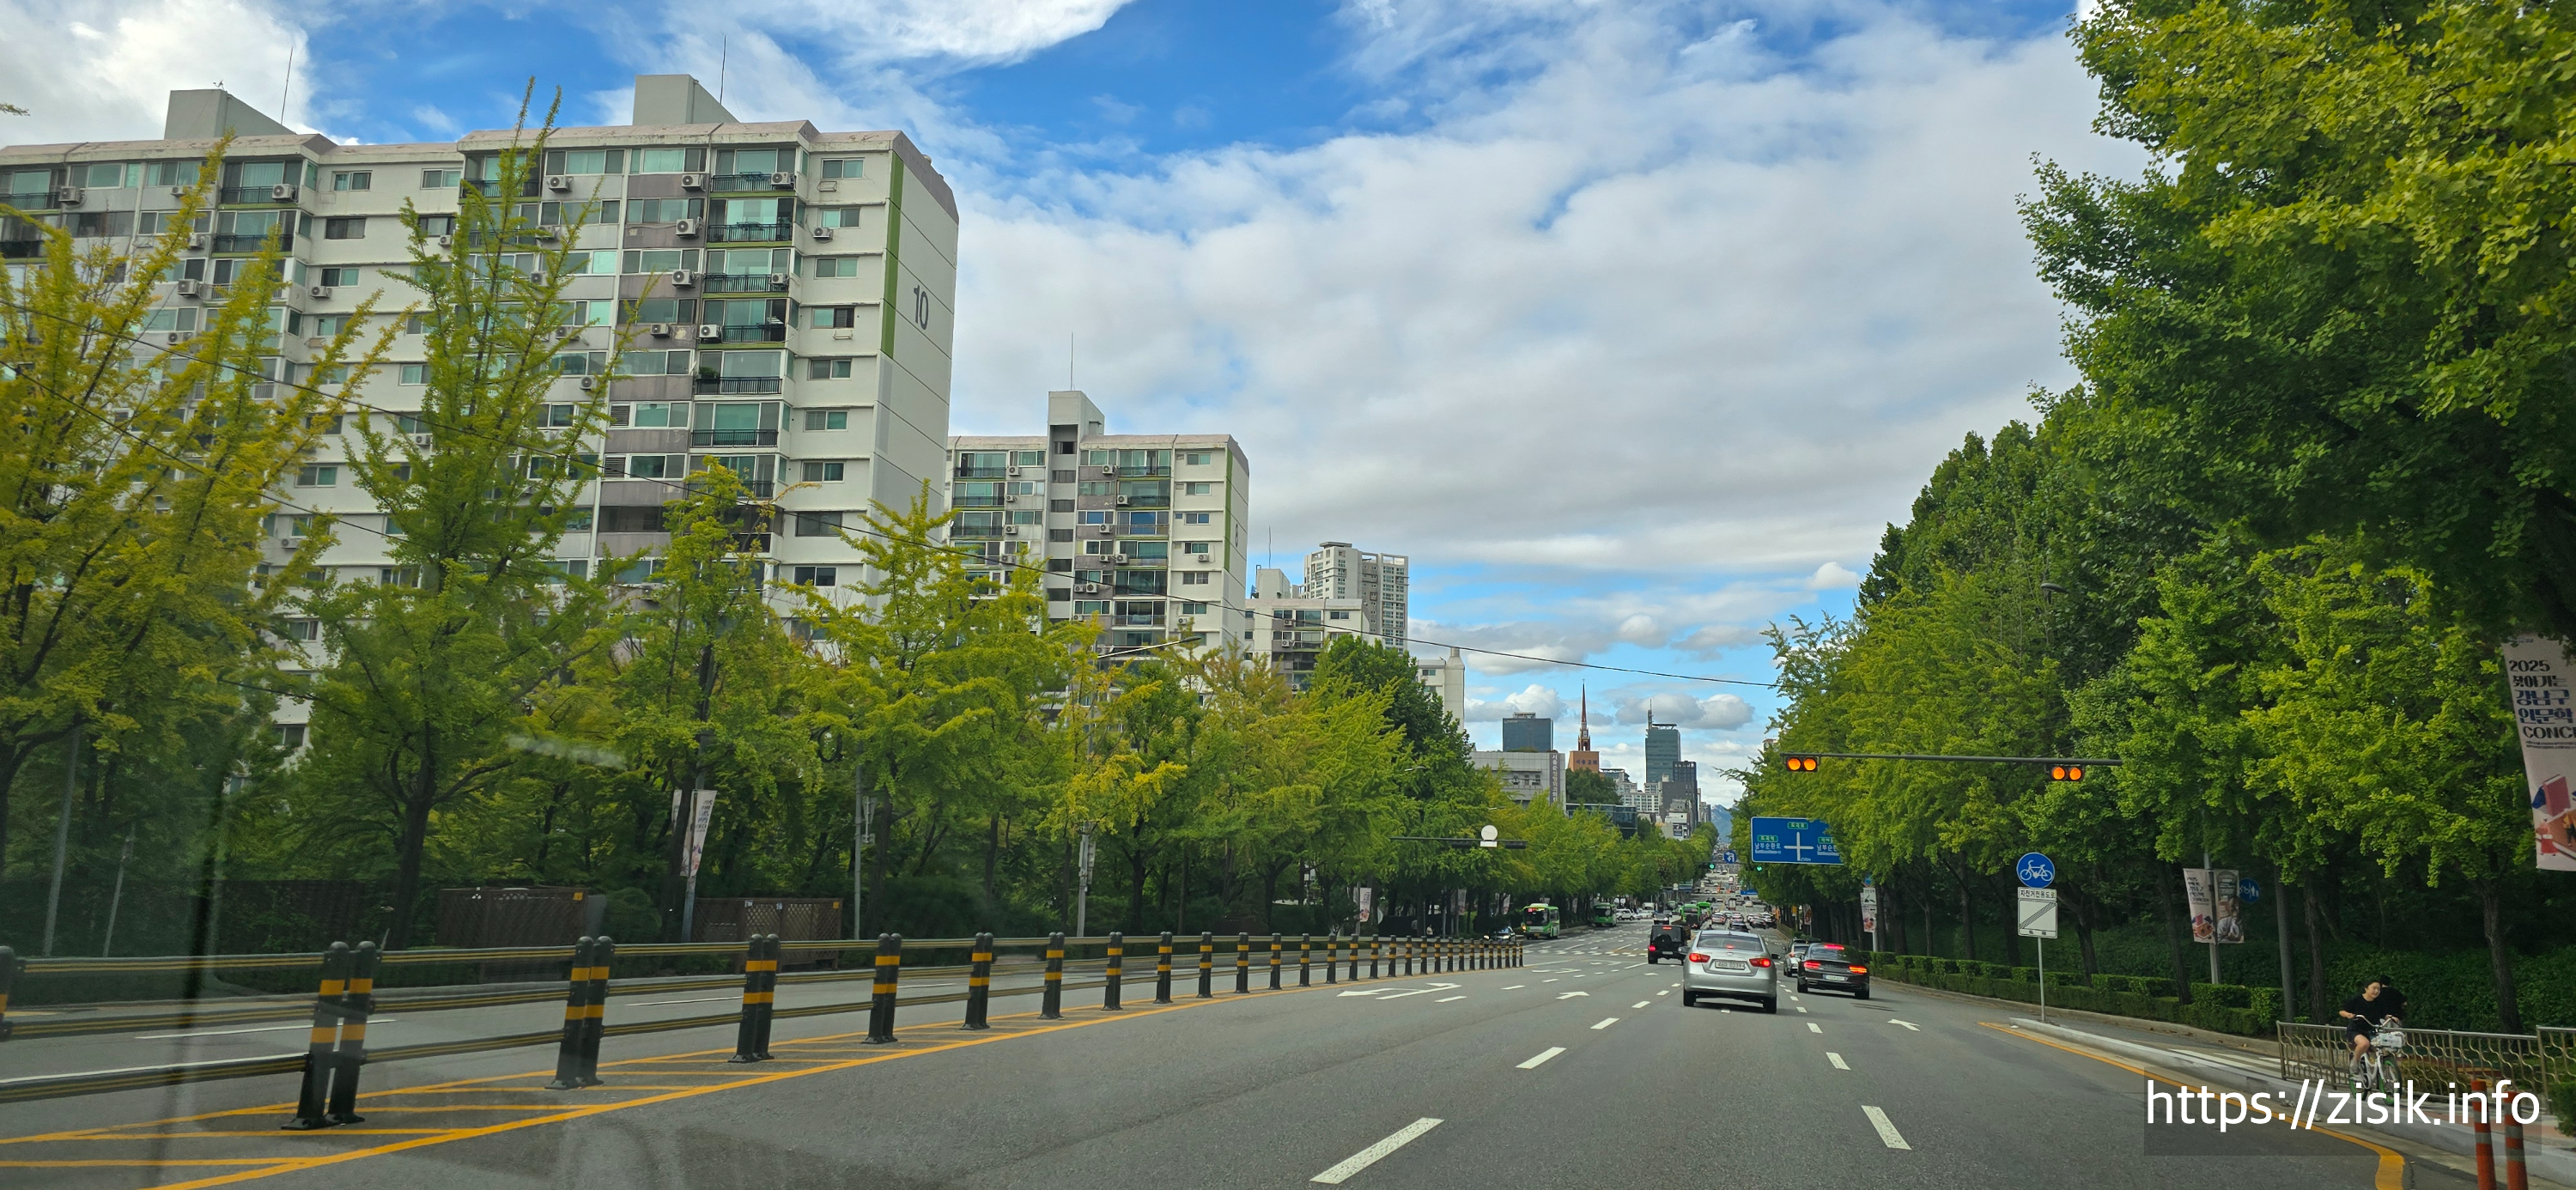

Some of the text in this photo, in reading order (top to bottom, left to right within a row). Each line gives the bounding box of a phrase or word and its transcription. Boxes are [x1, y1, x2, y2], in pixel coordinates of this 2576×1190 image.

[914, 285, 929, 330] 10
[1235, 524, 1238, 547] 8
[2509, 659, 2551, 672] 2025
[2514, 689, 2570, 706] 강남구
[2518, 707, 2573, 725] 인문학
[2020, 889, 2055, 899] 자전거전용도로
